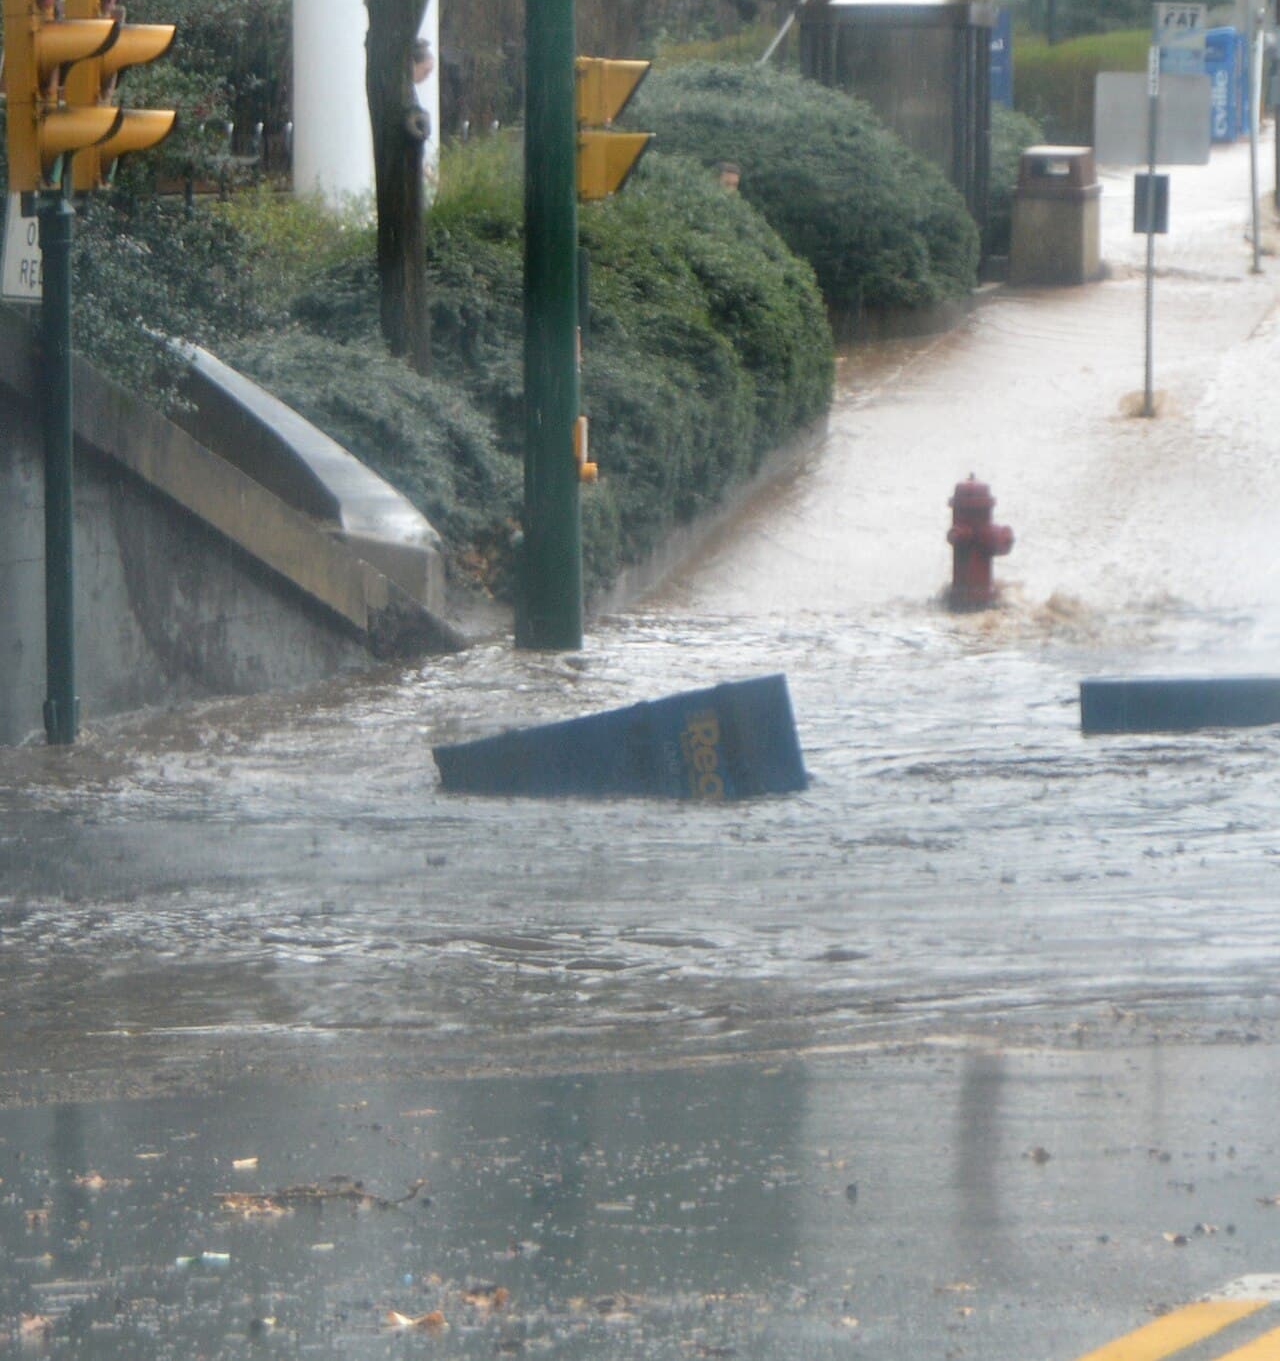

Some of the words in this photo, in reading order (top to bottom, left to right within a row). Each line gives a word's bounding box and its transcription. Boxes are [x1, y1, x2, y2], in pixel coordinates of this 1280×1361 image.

[1215, 70, 1228, 137] cville
[27, 221, 37, 247] O
[21, 259, 43, 289] RE
[688, 716, 724, 799] Rea
